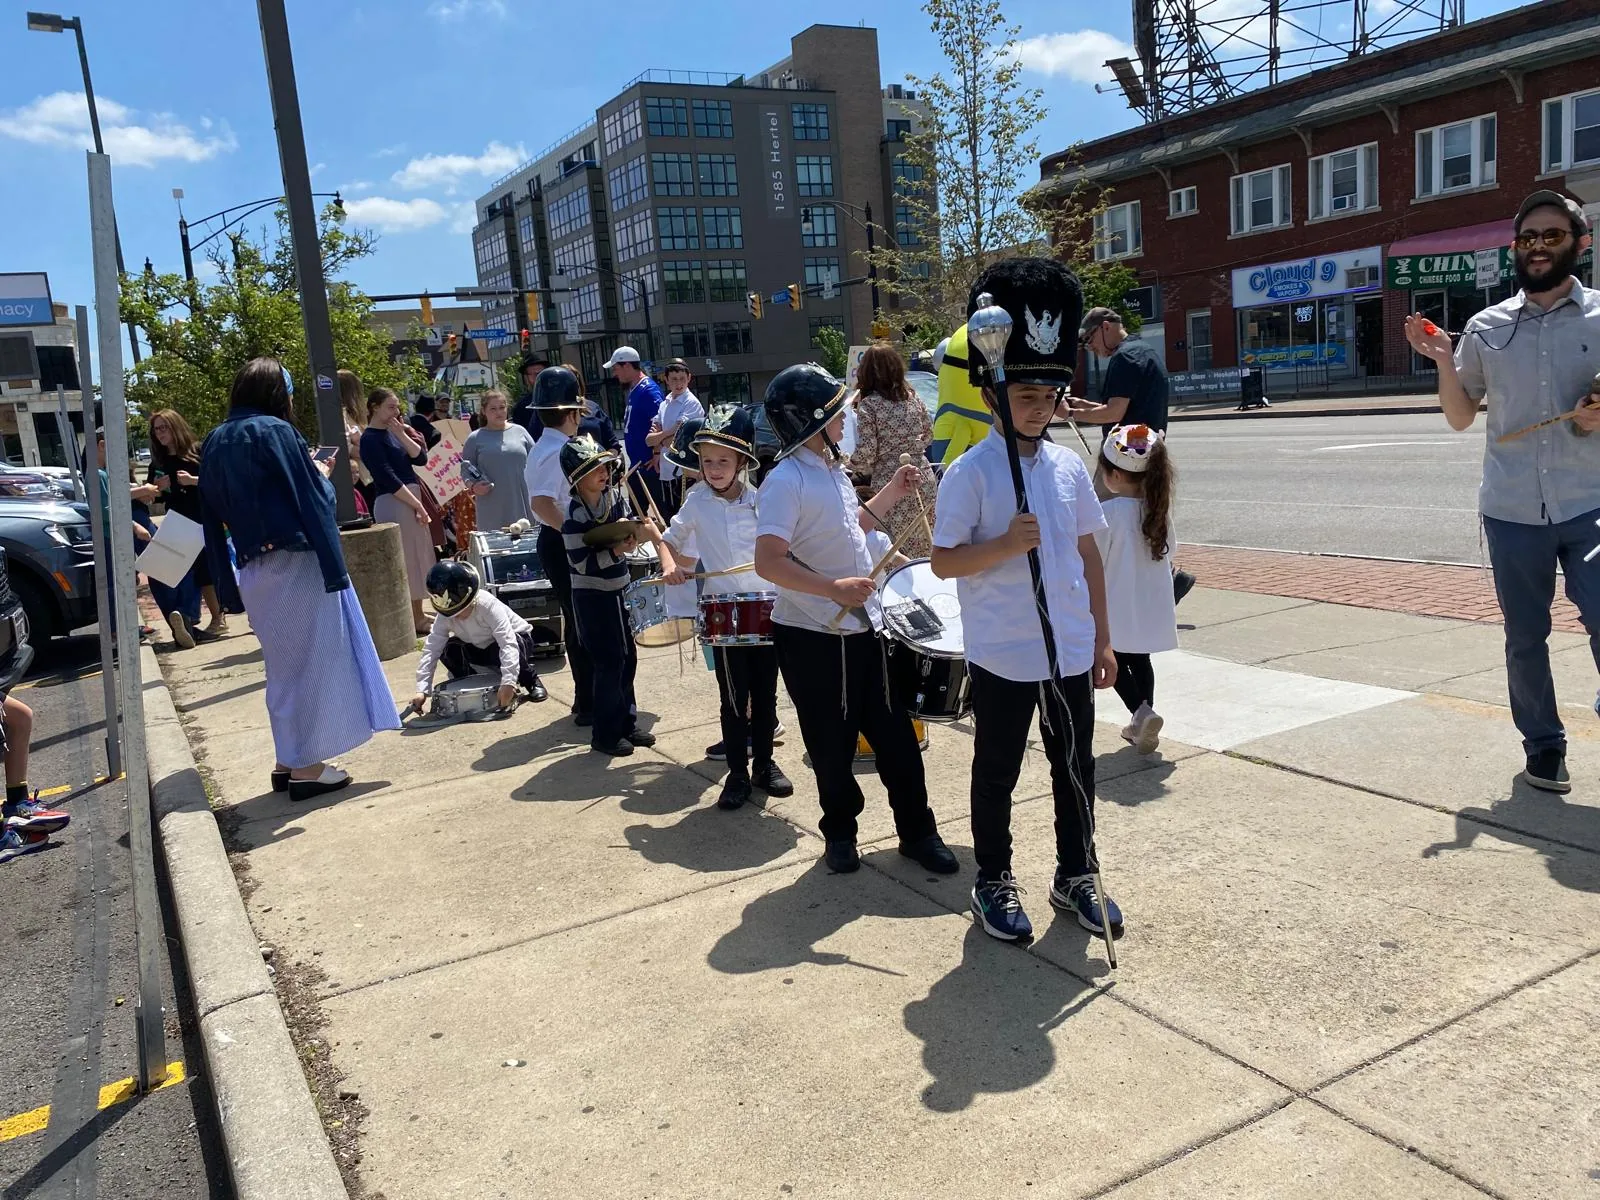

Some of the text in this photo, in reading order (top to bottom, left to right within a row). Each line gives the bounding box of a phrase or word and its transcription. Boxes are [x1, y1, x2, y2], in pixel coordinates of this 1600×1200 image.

[766, 112, 785, 212] 1585 Hertel
[1249, 258, 1337, 293] Cloud 9
[1419, 274, 1444, 284] CHINESE
[1445, 273, 1461, 282] FOOD
[1273, 283, 1298, 292] SMOKES
[1276, 288, 1301, 298] VAPORS
[471, 330, 498, 338] PARKSIDE
